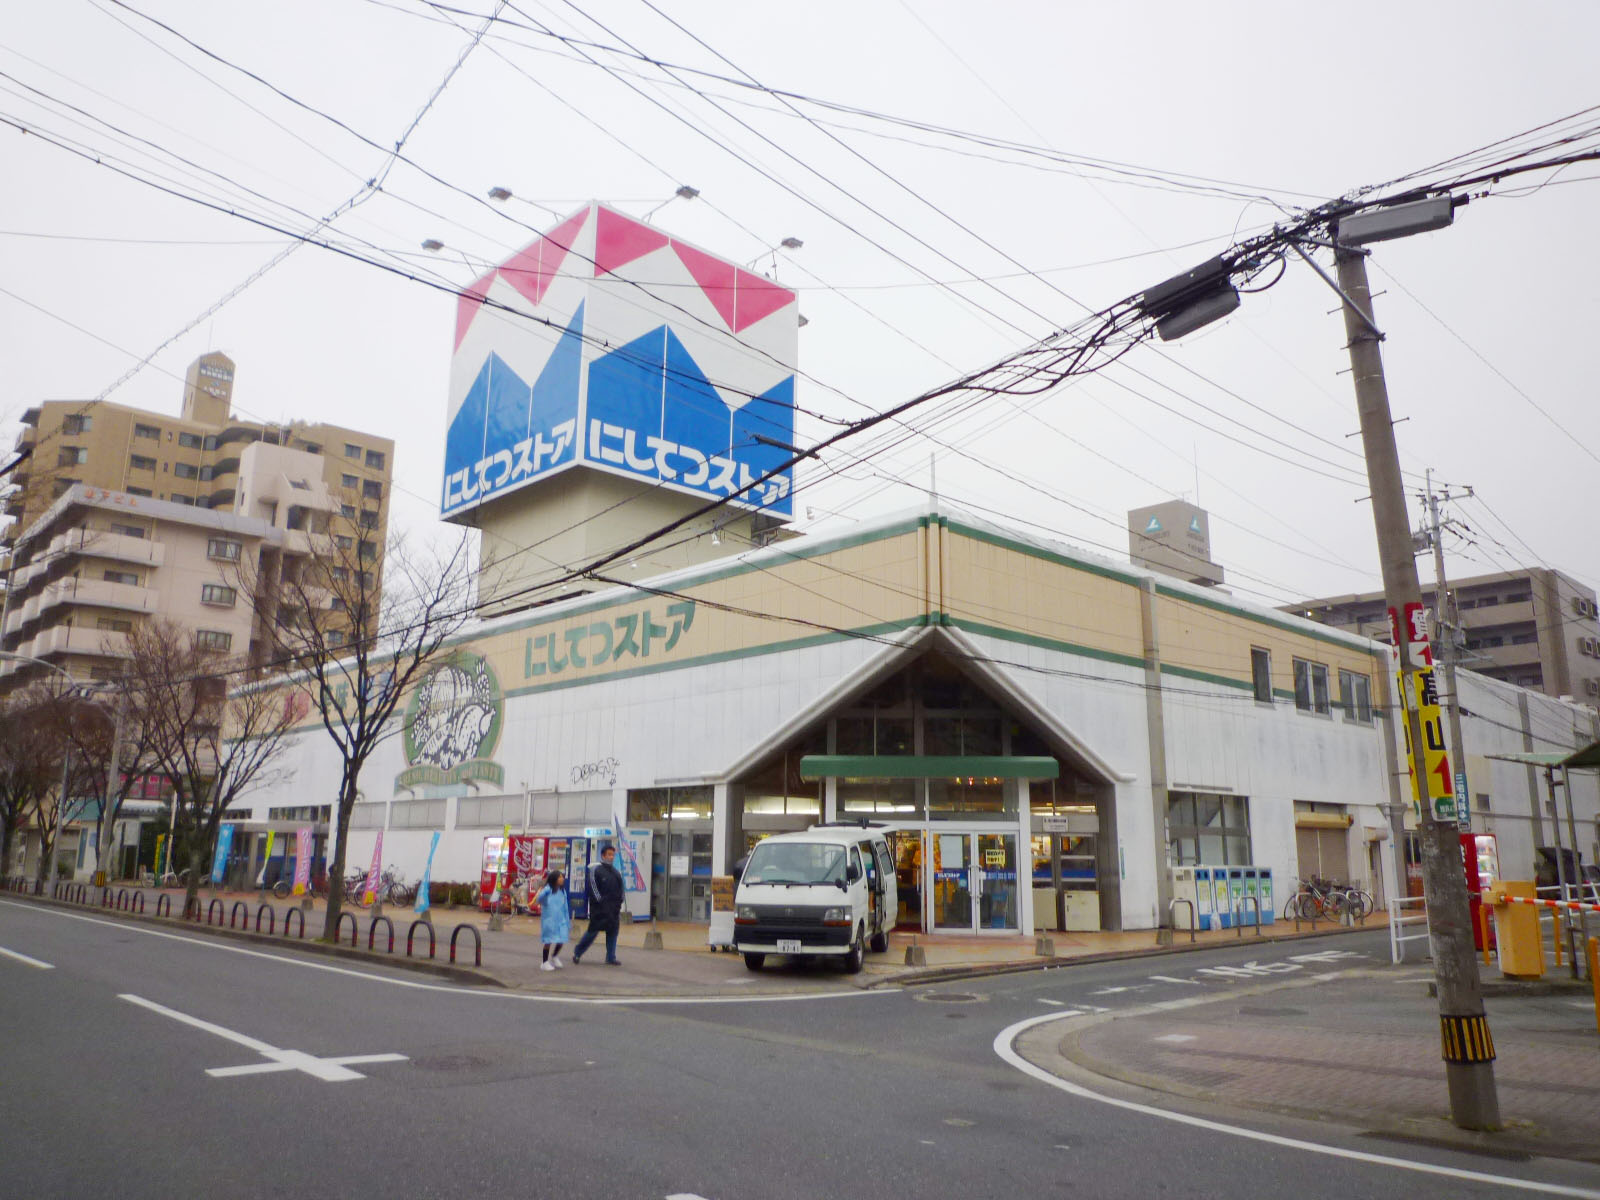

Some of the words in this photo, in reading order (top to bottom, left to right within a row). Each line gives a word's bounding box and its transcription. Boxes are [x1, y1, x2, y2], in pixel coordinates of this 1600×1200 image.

[444, 418, 576, 508] にしてつストア
[589, 417, 792, 506] にしてつストア
[525, 602, 695, 679] にしてつストア
